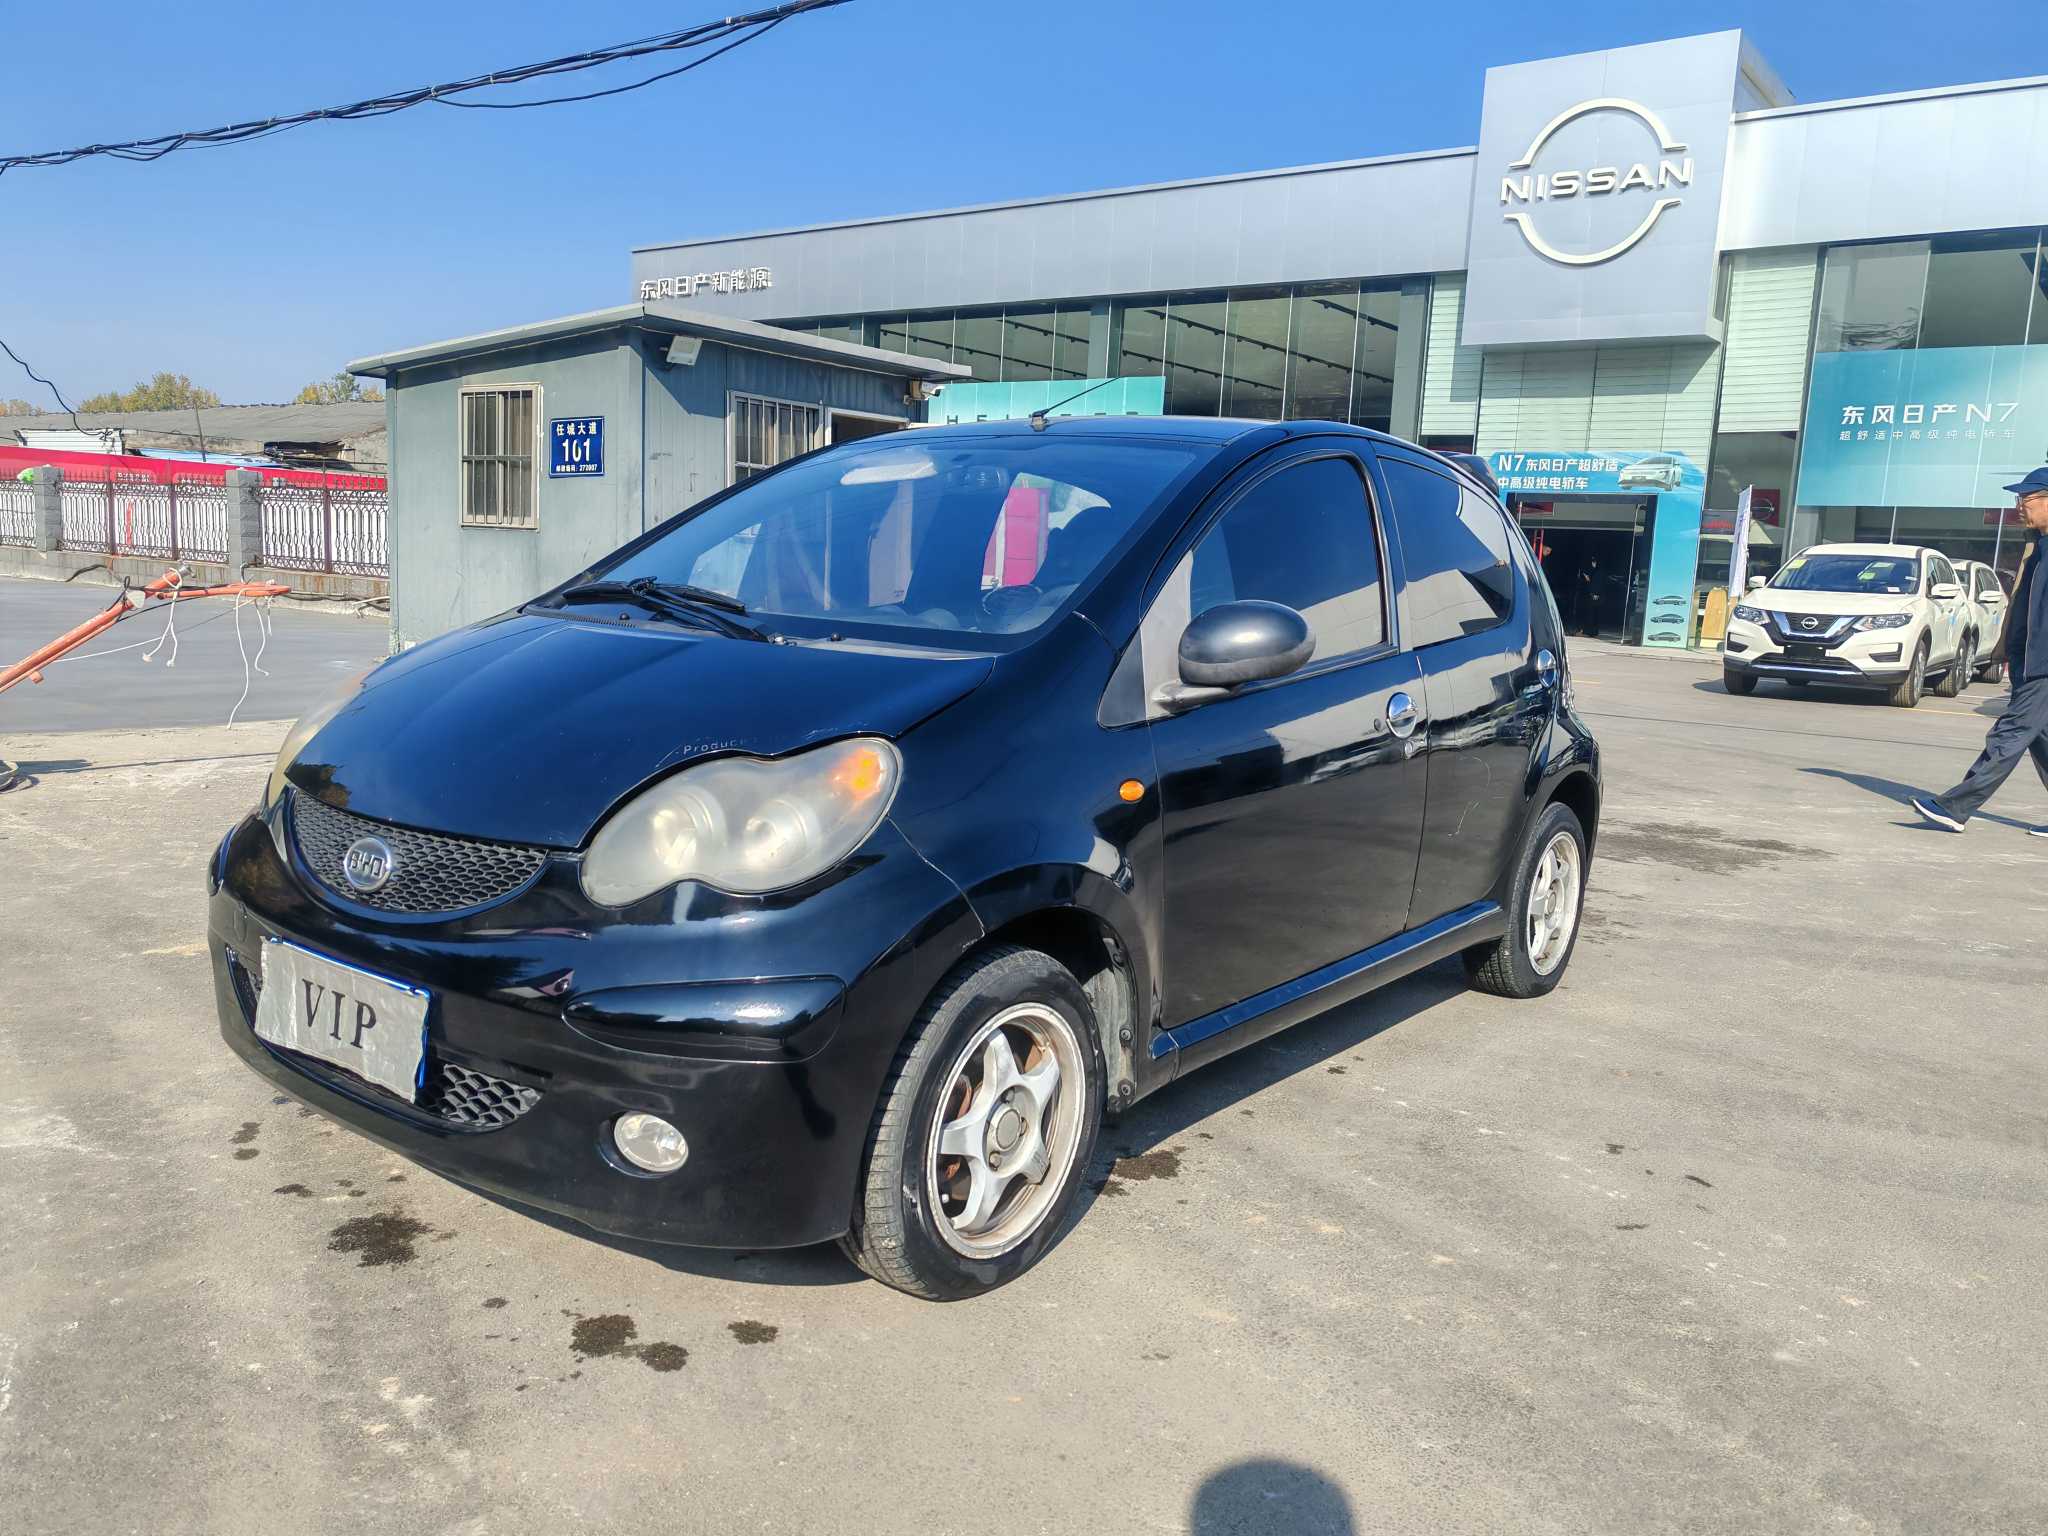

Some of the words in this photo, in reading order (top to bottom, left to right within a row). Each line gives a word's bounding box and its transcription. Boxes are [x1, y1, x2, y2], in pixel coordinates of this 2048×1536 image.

[1500, 157, 1694, 204] NISSAN
[640, 266, 773, 300] 东风日产新能源
[562, 438, 591, 463] 101
[1498, 476, 1590, 490] 中高级纯电轿车
[302, 978, 377, 1049] VIP
